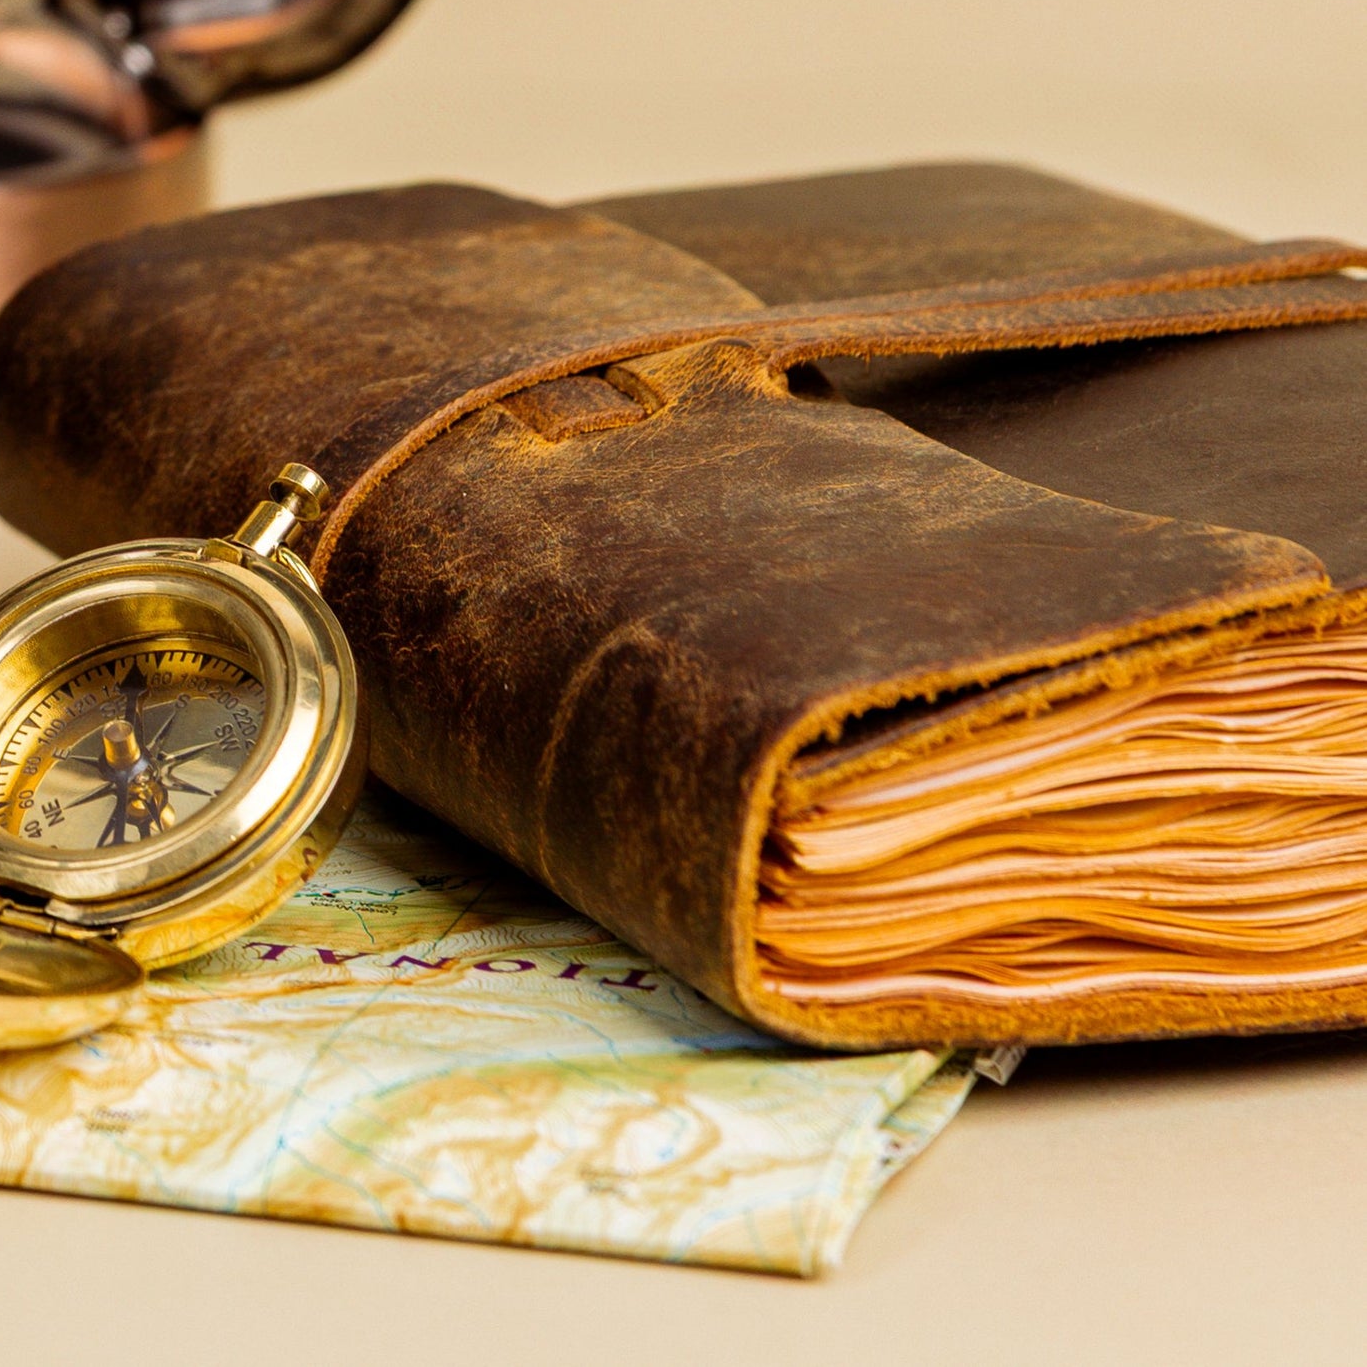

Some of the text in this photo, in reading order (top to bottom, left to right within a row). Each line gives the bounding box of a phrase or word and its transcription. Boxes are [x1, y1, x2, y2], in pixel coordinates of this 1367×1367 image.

[180, 673, 210, 692] 180
[65, 692, 97, 717] 120
[175, 692, 191, 709] S
[209, 684, 239, 711] 200
[38, 718, 66, 746] 100
[232, 708, 257, 736] 220
[214, 722, 242, 753] SW
[22, 756, 42, 776] 80
[53, 747, 70, 761] E
[18, 789, 35, 810] 60
[41, 798, 66, 828] NE
[23, 819, 43, 838] 40
[243, 941, 692, 998] TIONAL
